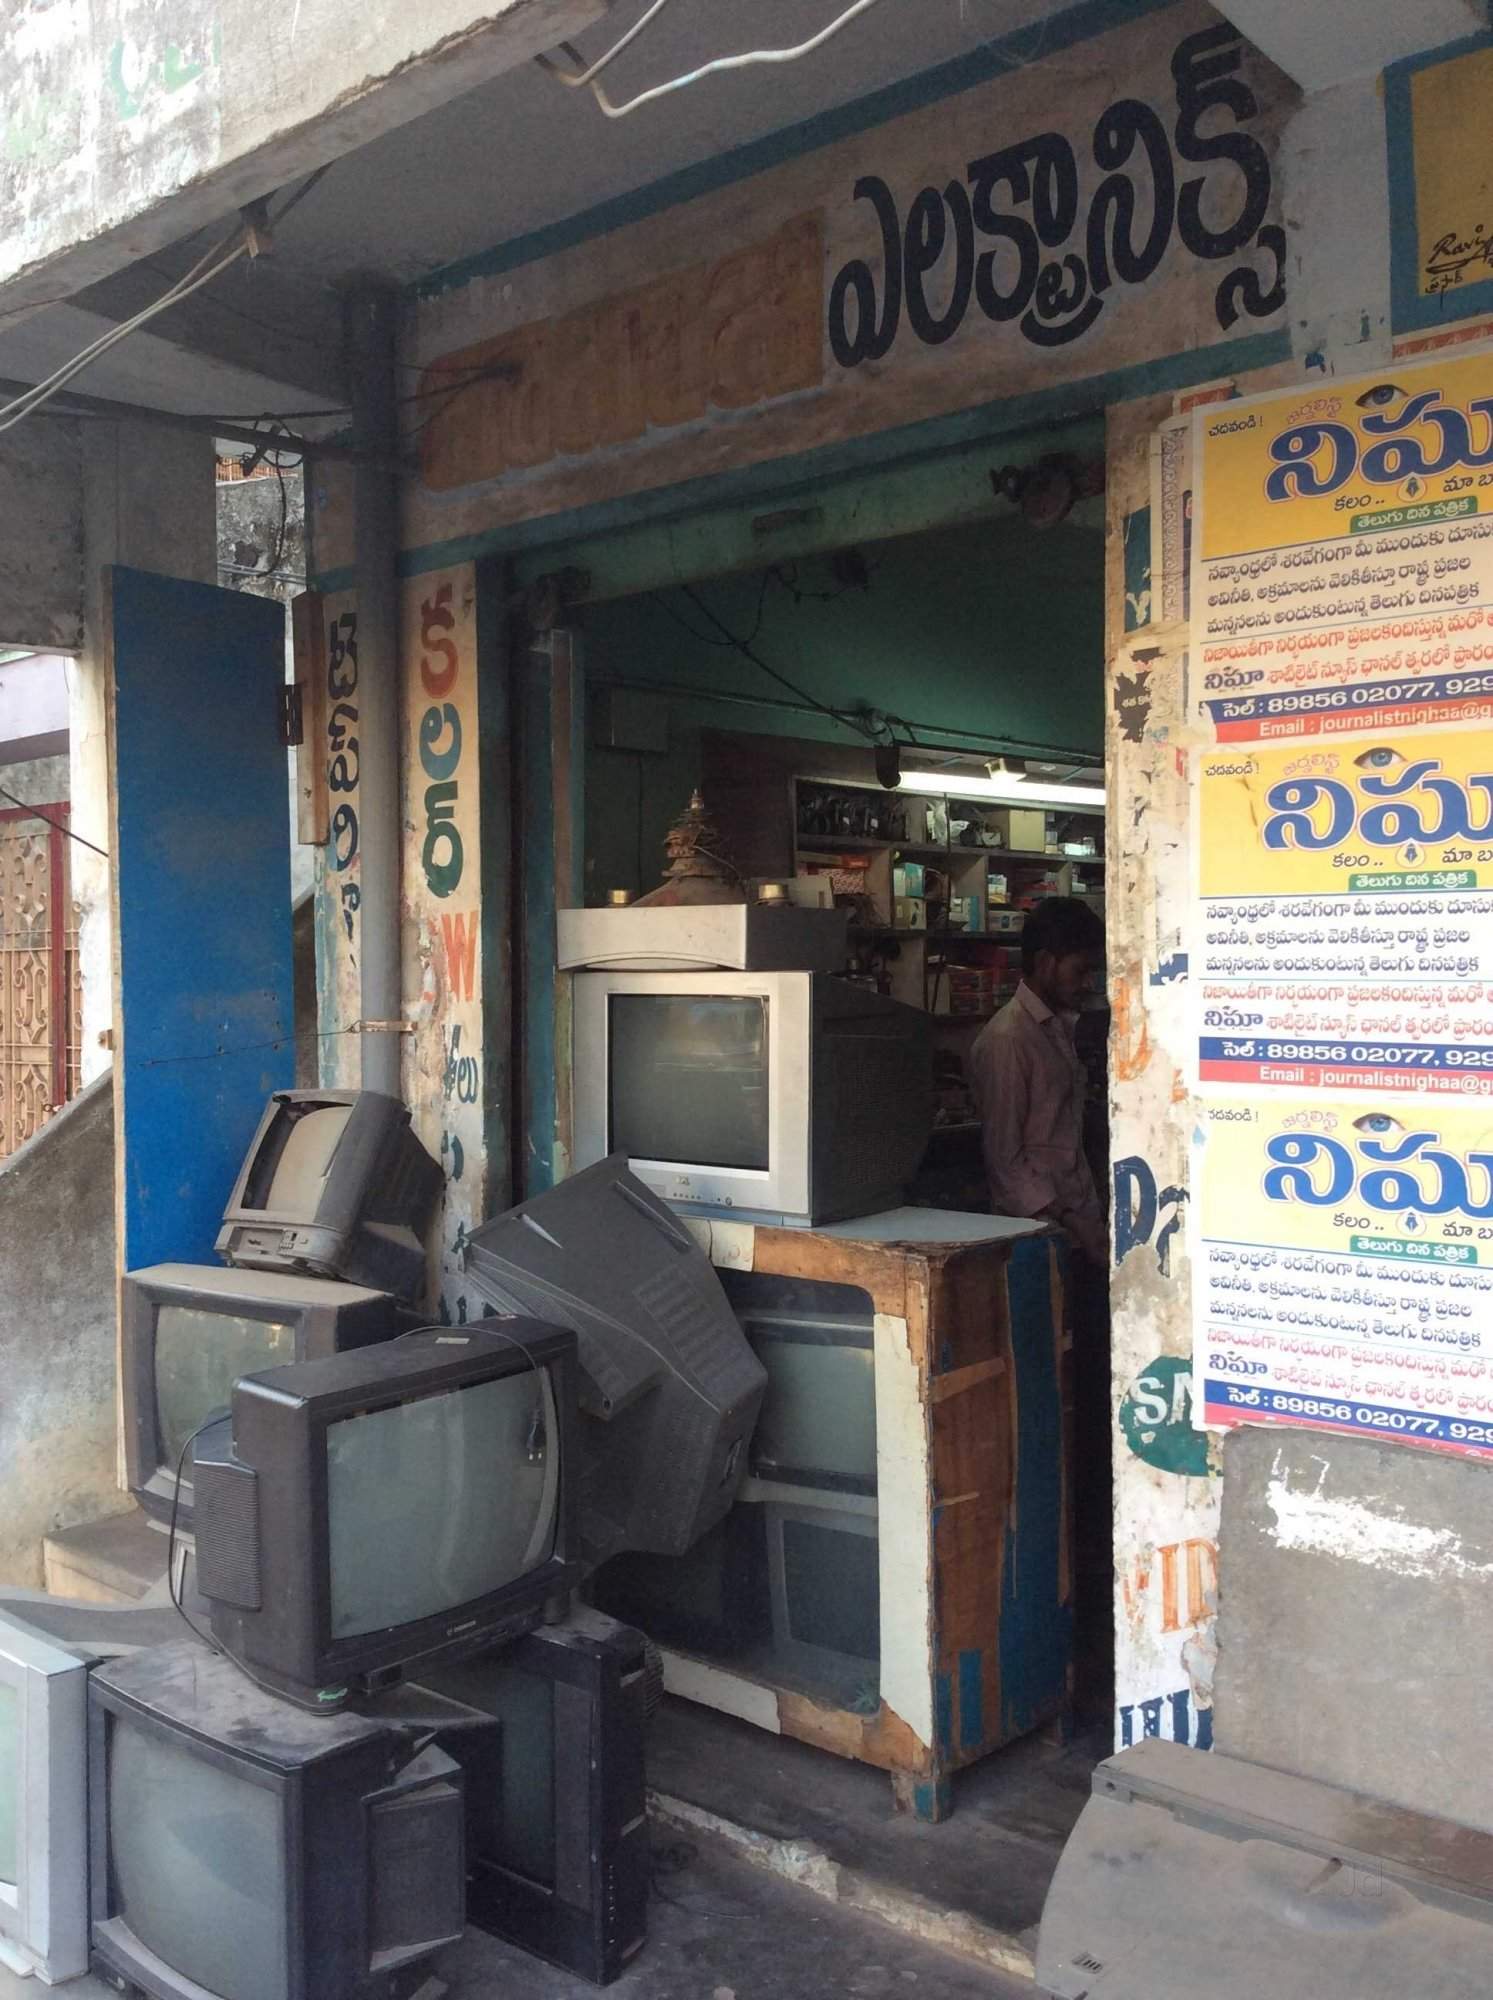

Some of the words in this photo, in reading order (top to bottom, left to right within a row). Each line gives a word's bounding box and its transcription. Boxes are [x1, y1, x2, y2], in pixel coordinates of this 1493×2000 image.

[1358, 511, 1404, 530] తెలుగు
[1434, 500, 1469, 519] పత్రిక
[1376, 533, 1444, 555] ముందుకు
[1434, 555, 1471, 576] ప్రజల
[1370, 592, 1415, 611] తెలుగు
[1419, 582, 1480, 604] దినపత్రిక
[1223, 698, 1255, 718] సెల్
[1268, 692, 1348, 713] 89856
[1260, 719, 1305, 737] Email
[1357, 874, 1403, 888] తెలుగు
[1432, 872, 1468, 889] పత్రిక
[1375, 899, 1443, 916] ముందుకు
[1433, 927, 1470, 949] ప్రజల
[1369, 955, 1415, 973] తెలుగు
[1418, 955, 1480, 977] దినపత్రిక
[1222, 1040, 1255, 1058] సెల్
[1268, 1043, 1347, 1061] 89856
[1260, 1066, 1304, 1082] Email
[1319, 1067, 1493, 1096] journalistnighaa@g
[1272, 1394, 1352, 1421] 89856
